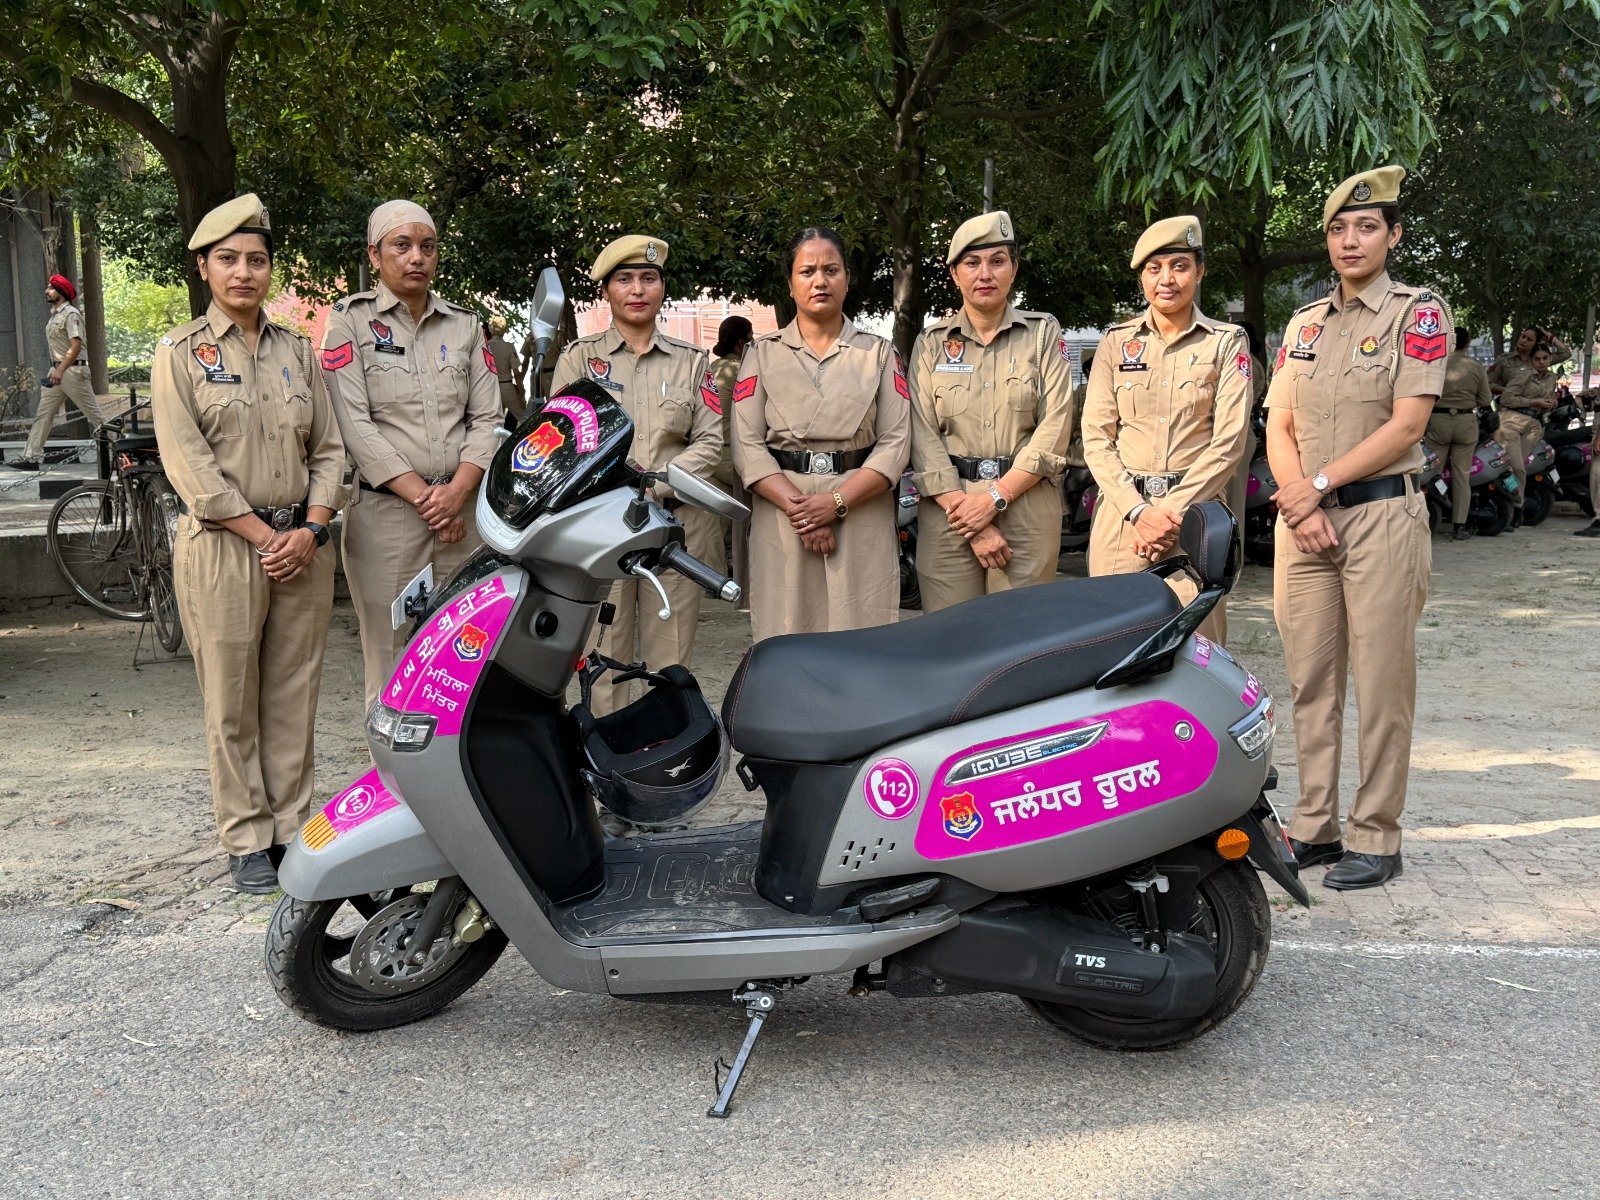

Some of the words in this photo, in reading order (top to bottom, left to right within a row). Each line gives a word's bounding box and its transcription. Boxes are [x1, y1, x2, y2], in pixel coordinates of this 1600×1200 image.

[544, 398, 585, 414] PUNJAB
[577, 409, 595, 450] POLICE
[426, 665, 470, 692] ਮਹਿਲਾ
[421, 683, 459, 712] ਮਿੱਤਰ
[1042, 742, 1078, 755] ELECTRIC
[880, 780, 907, 798] 112
[990, 781, 1082, 826] ਜਲੰਧਰ
[1092, 760, 1161, 810] ਰੂਰਲ
[350, 795, 364, 811] 112
[1074, 953, 1106, 968] TVS
